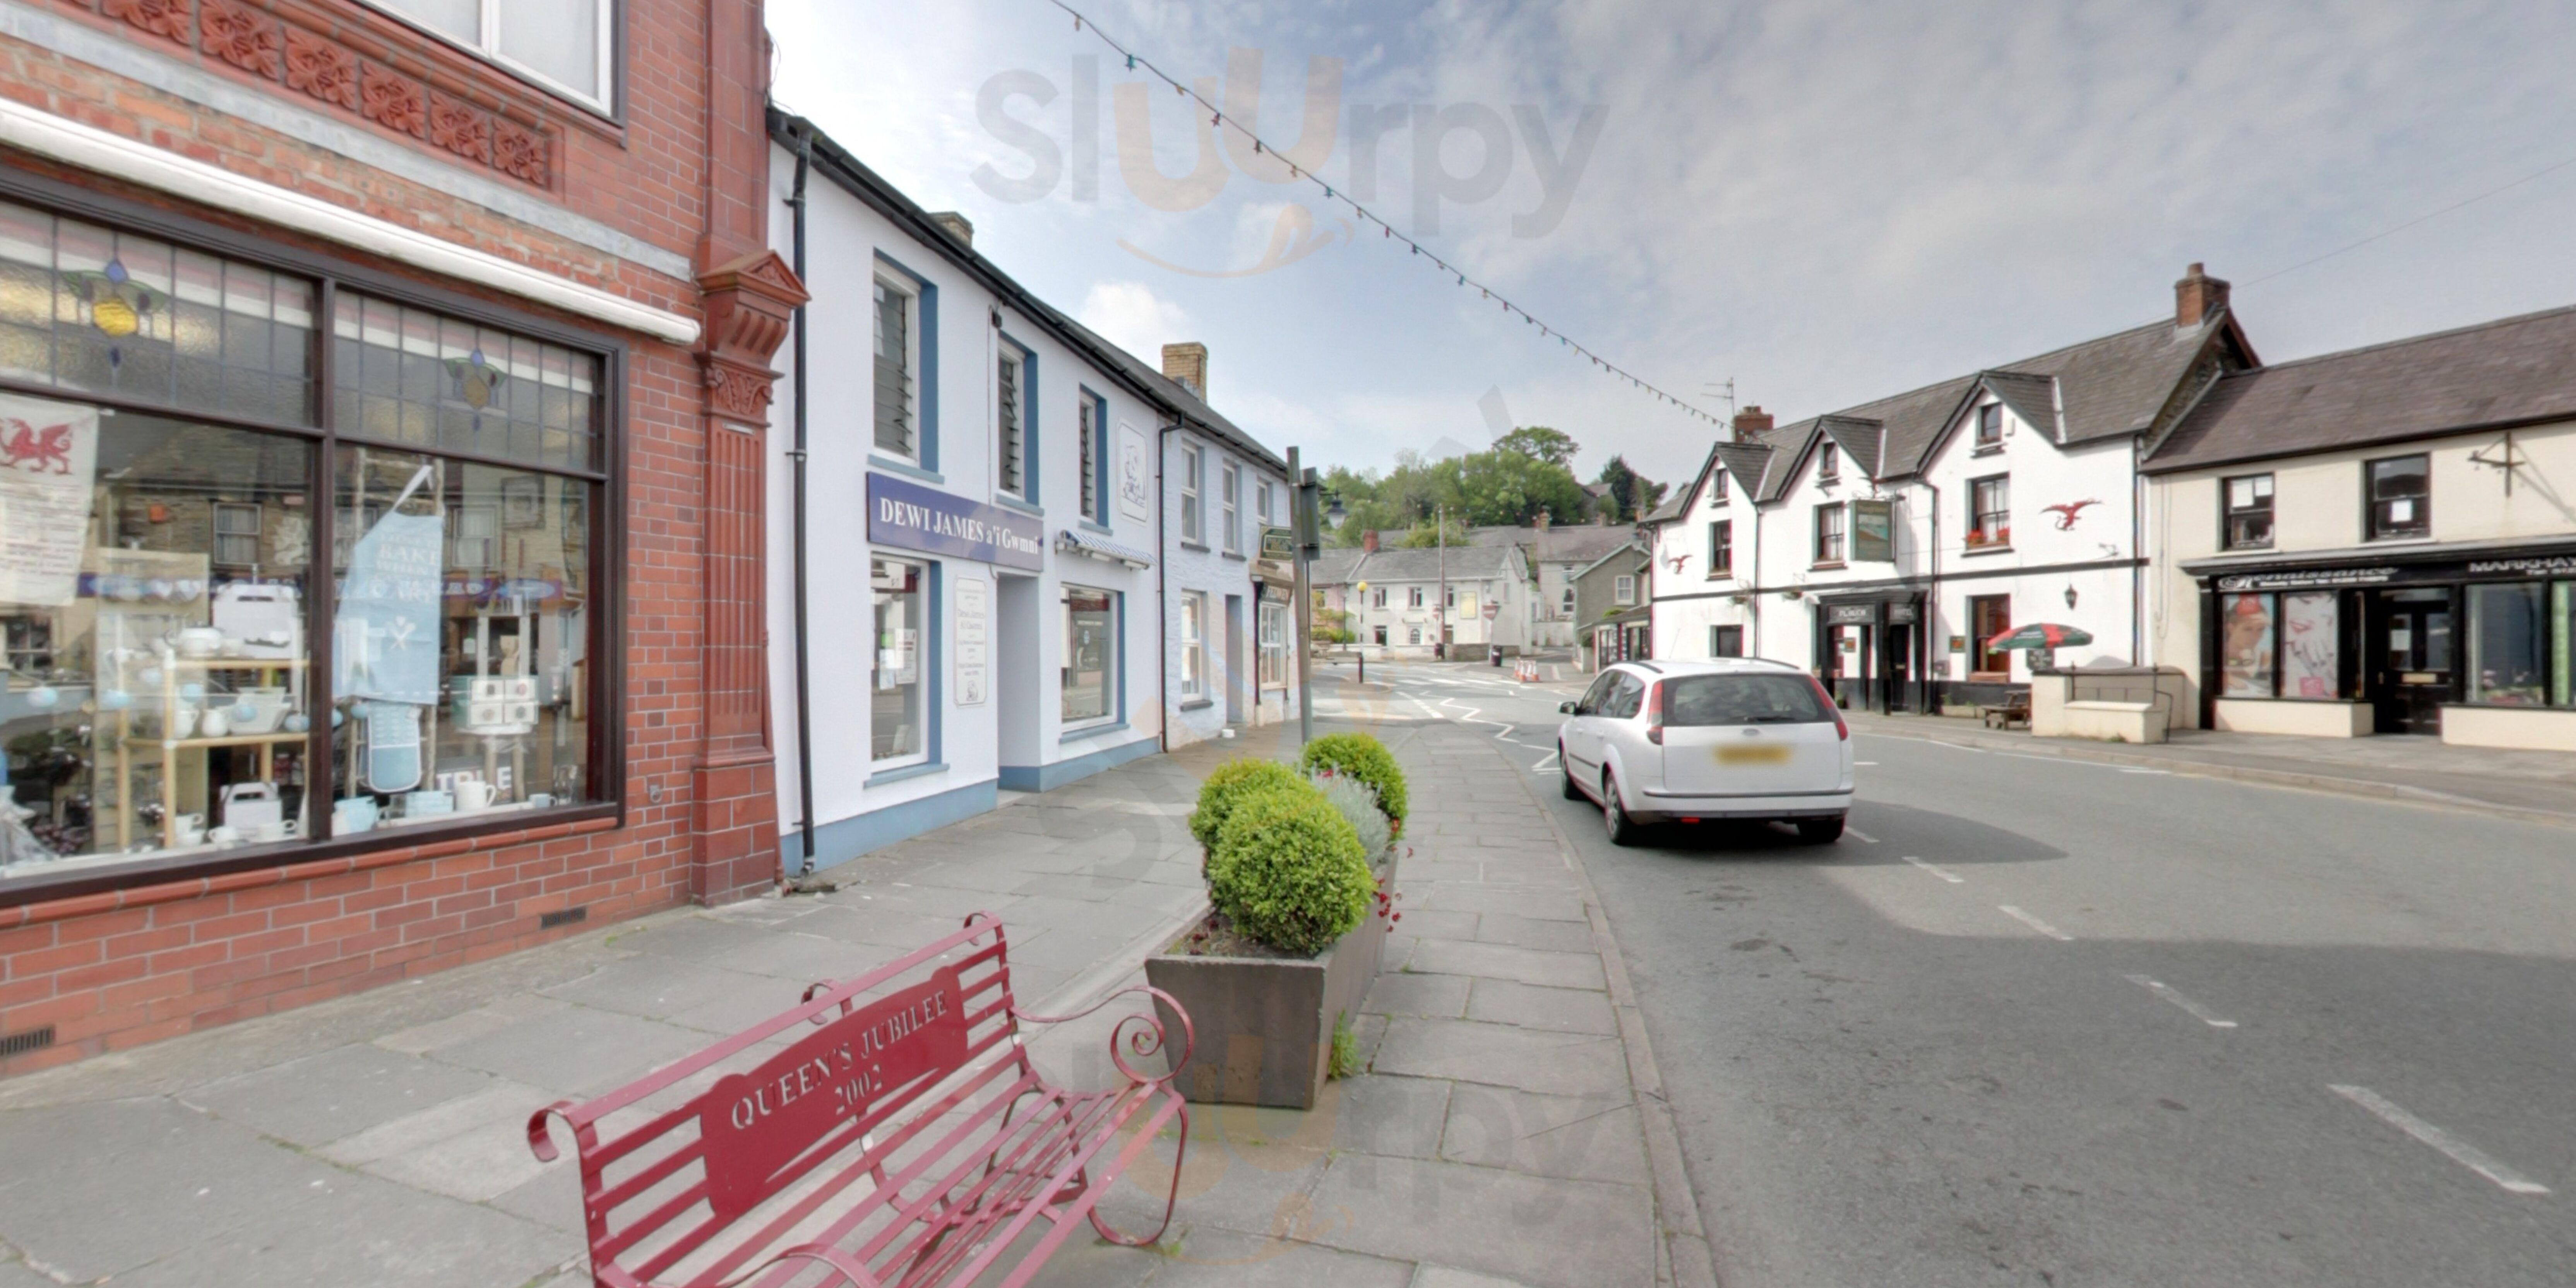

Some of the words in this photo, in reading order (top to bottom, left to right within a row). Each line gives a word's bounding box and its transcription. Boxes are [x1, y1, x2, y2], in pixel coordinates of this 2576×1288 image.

[880, 497, 930, 531] DEWI
[933, 511, 983, 543] JAMES
[986, 525, 1000, 546] a'i
[1002, 528, 1038, 554] Gwmni
[731, 1042, 853, 1130] QUEEN'S
[861, 990, 949, 1059] JUBILEE
[835, 1064, 883, 1115] 2002
